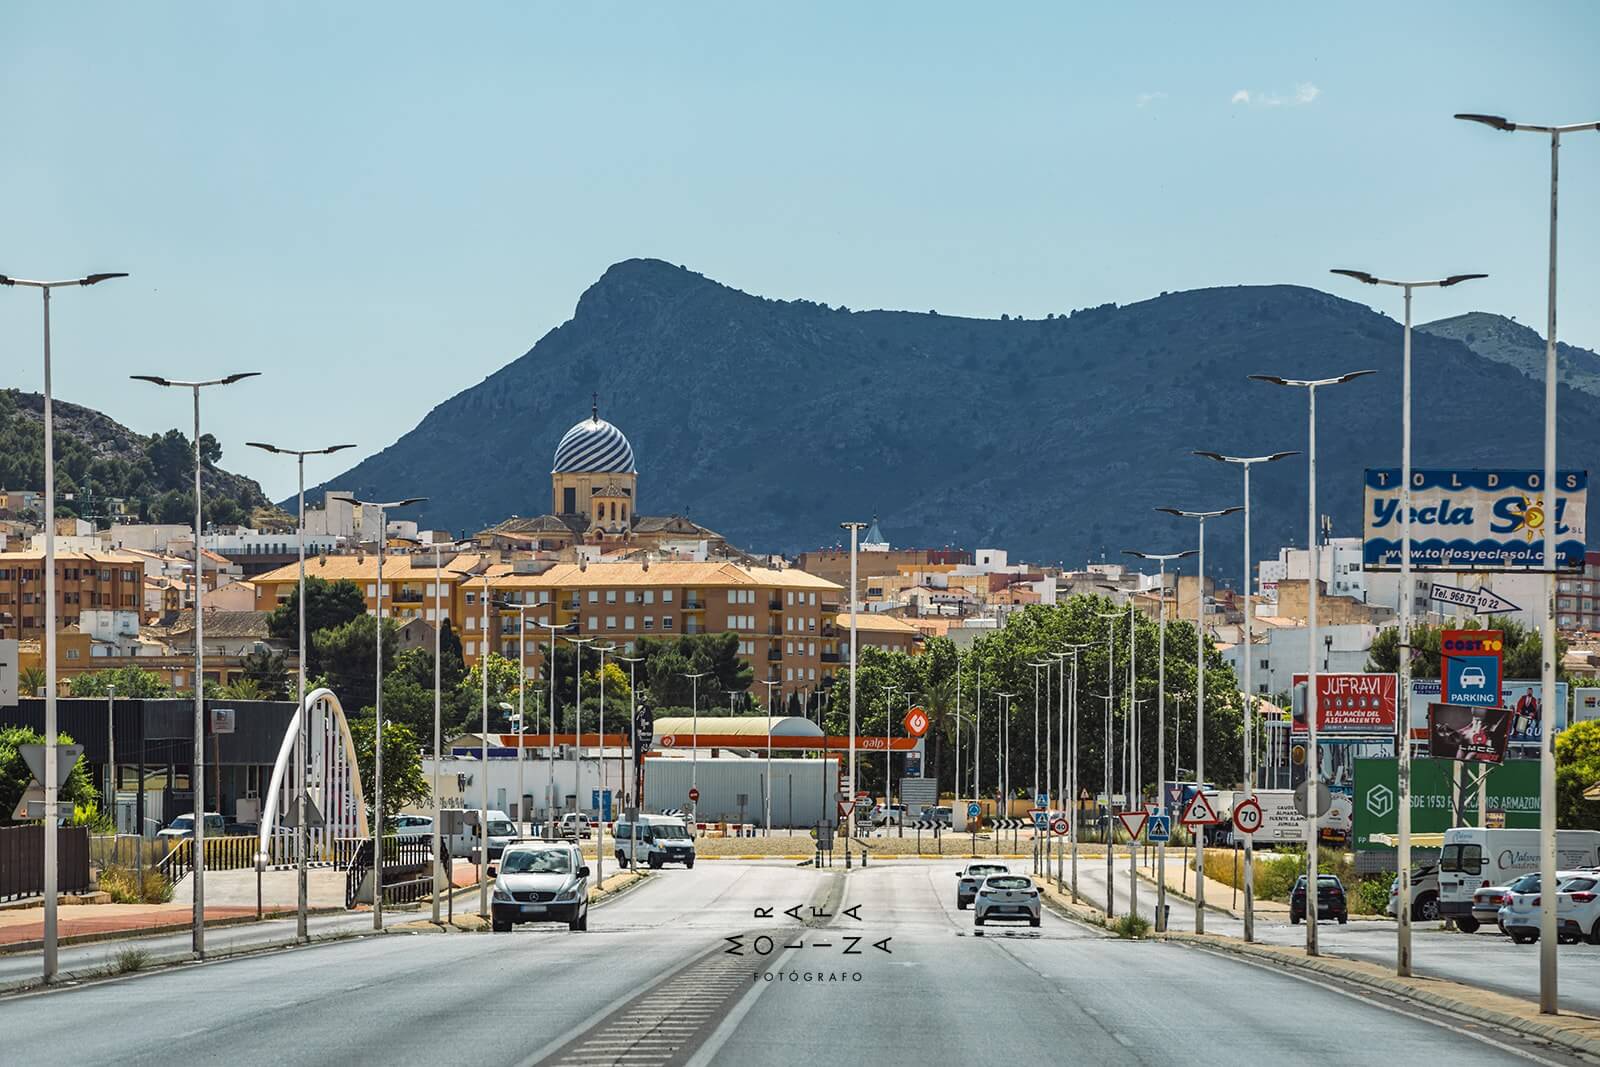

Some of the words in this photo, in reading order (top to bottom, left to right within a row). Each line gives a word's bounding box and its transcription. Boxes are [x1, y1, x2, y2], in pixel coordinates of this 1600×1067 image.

[1378, 472, 1577, 488] TOLDOS
[1372, 498, 1474, 528] Yecla
[1385, 548, 1566, 560] ww.toldosyeclasol.cm
[1450, 592, 1464, 601] 968
[1465, 594, 1475, 604] 79
[1478, 597, 1487, 607] 10
[1488, 599, 1499, 609] 22
[1322, 677, 1380, 695] JUFRAVI
[1451, 694, 1494, 702] PARKING
[863, 738, 884, 749] galp
[1427, 795, 1446, 808] 1953
[1500, 796, 1541, 809] ARMAZON
[1241, 811, 1257, 822] 70
[1056, 823, 1065, 831] 40
